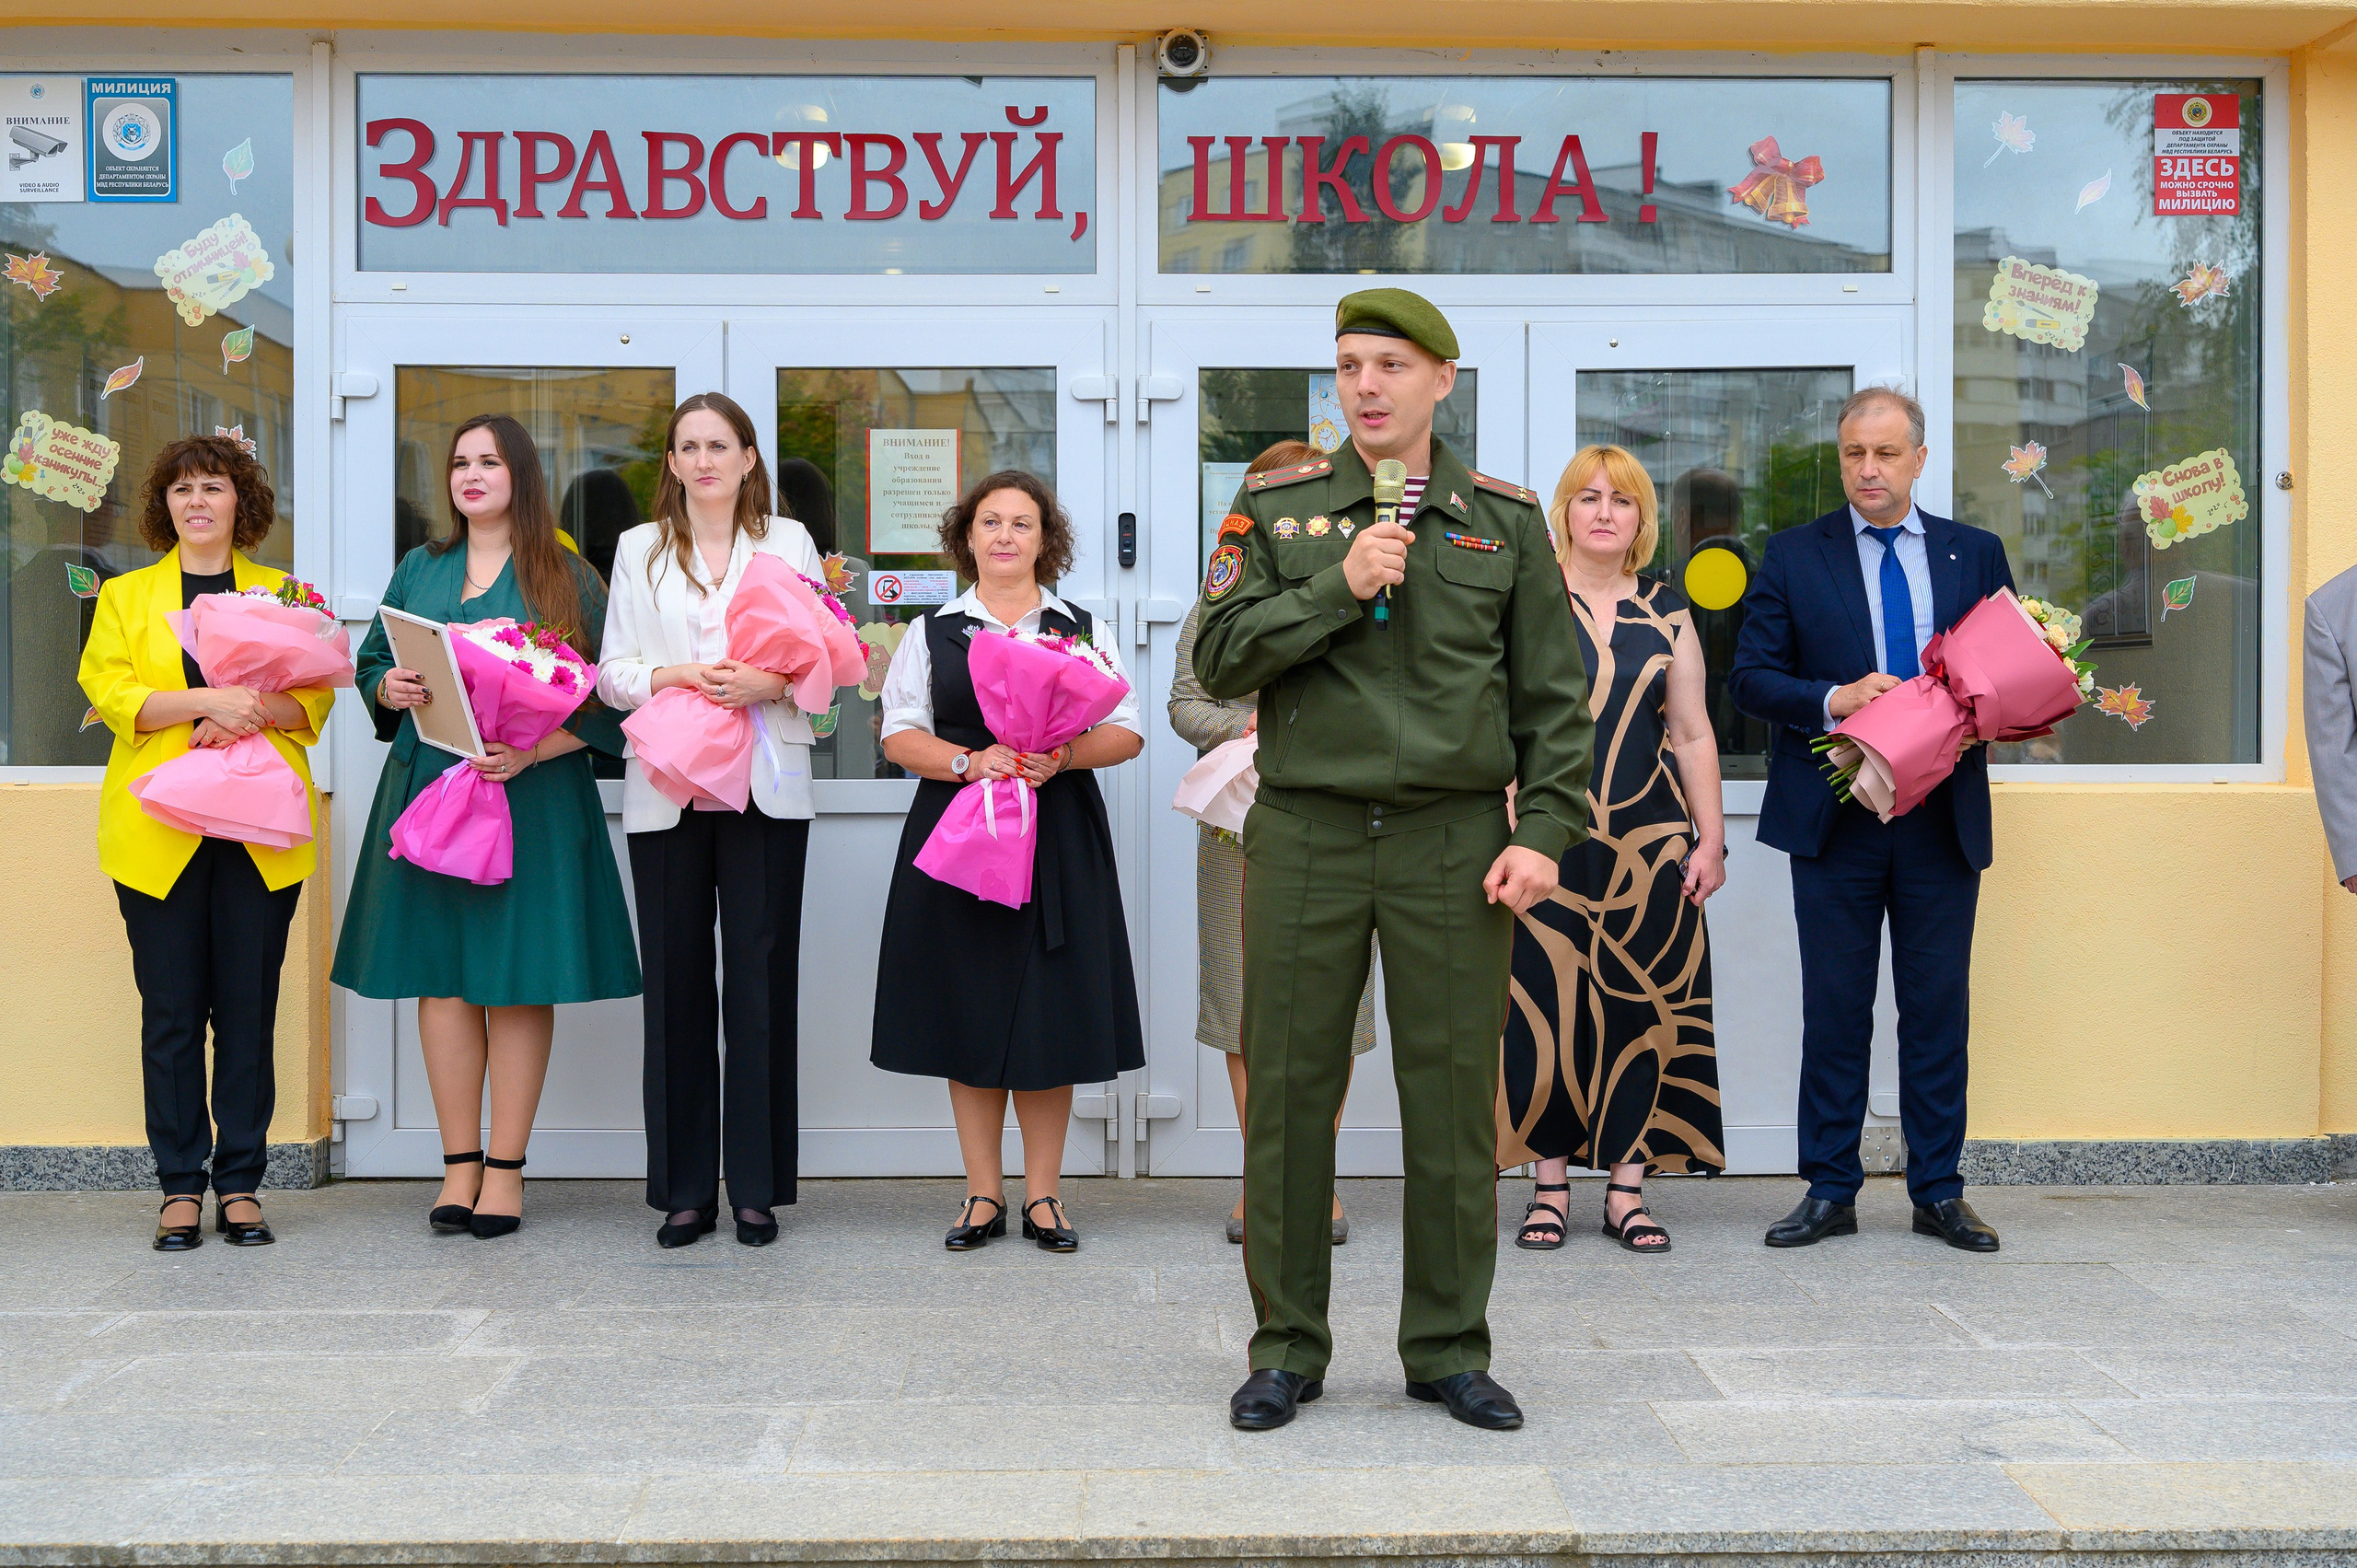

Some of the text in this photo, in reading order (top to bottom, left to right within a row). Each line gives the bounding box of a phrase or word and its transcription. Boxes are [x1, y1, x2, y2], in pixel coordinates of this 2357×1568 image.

[91, 83, 172, 96] МИЛИЦИЯ
[6, 116, 71, 125] ВНИМАНИЕ
[365, 105, 1088, 242] ЗДРАВСТВУЙ,
[2160, 158, 2235, 180] ЗДЕСЬ
[2176, 190, 2218, 198] ВЫЗВАТЬ
[2197, 180, 2235, 189] СРОЧНО
[2158, 198, 2235, 212] МИЛИЦИЮ
[183, 232, 221, 259] Буду
[173, 229, 250, 285] отличницей!
[2011, 262, 2074, 296] Вперёд
[2007, 285, 2082, 315] знаниям!
[52, 427, 111, 459] уже жду
[883, 438, 950, 447] ВНИМАНИЕ!
[49, 443, 103, 470] осенние
[904, 452, 923, 460] Вход
[33, 452, 106, 489] каникулы...
[893, 465, 941, 473] учреждение
[2162, 461, 2212, 487] Снова
[891, 476, 942, 485] образования
[2171, 471, 2226, 505] школу!
[882, 489, 922, 497] разрешен
